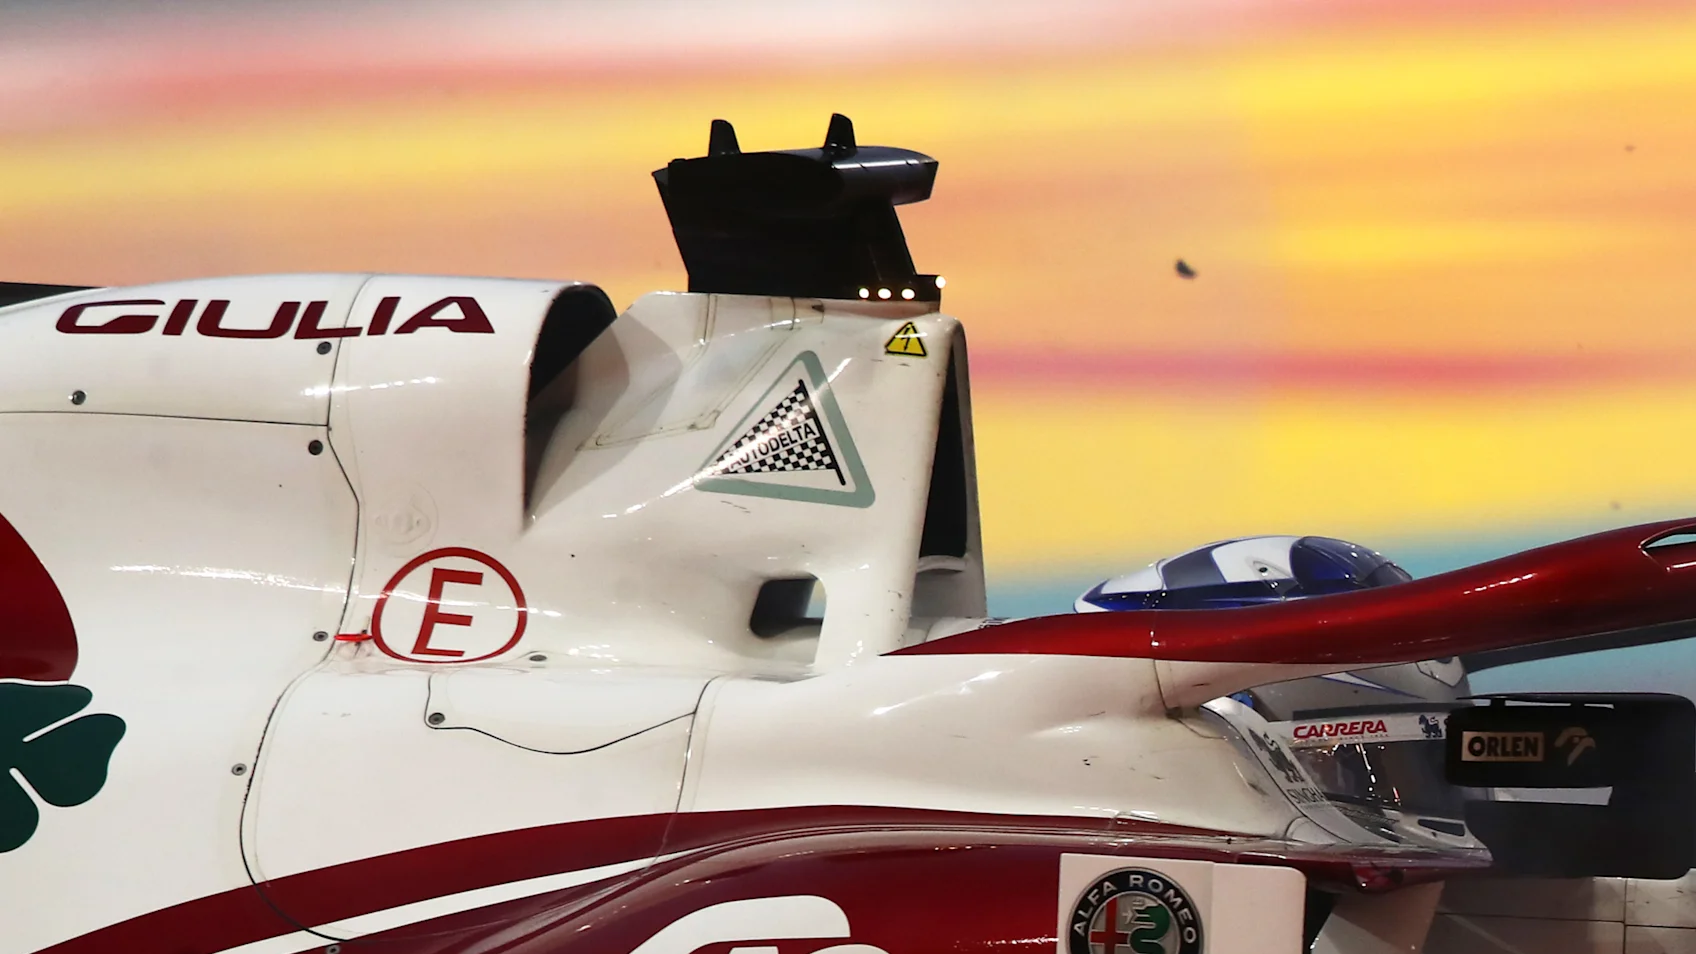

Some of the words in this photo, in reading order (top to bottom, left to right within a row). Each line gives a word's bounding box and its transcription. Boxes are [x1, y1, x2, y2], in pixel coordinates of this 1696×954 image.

[56, 296, 495, 339] GIULIA
[411, 567, 483, 657] E
[1293, 719, 1388, 739] CARRERA
[1468, 736, 1539, 757] ORLEN
[1074, 881, 1118, 937] ALFA
[1129, 874, 1197, 944] ROMEO
